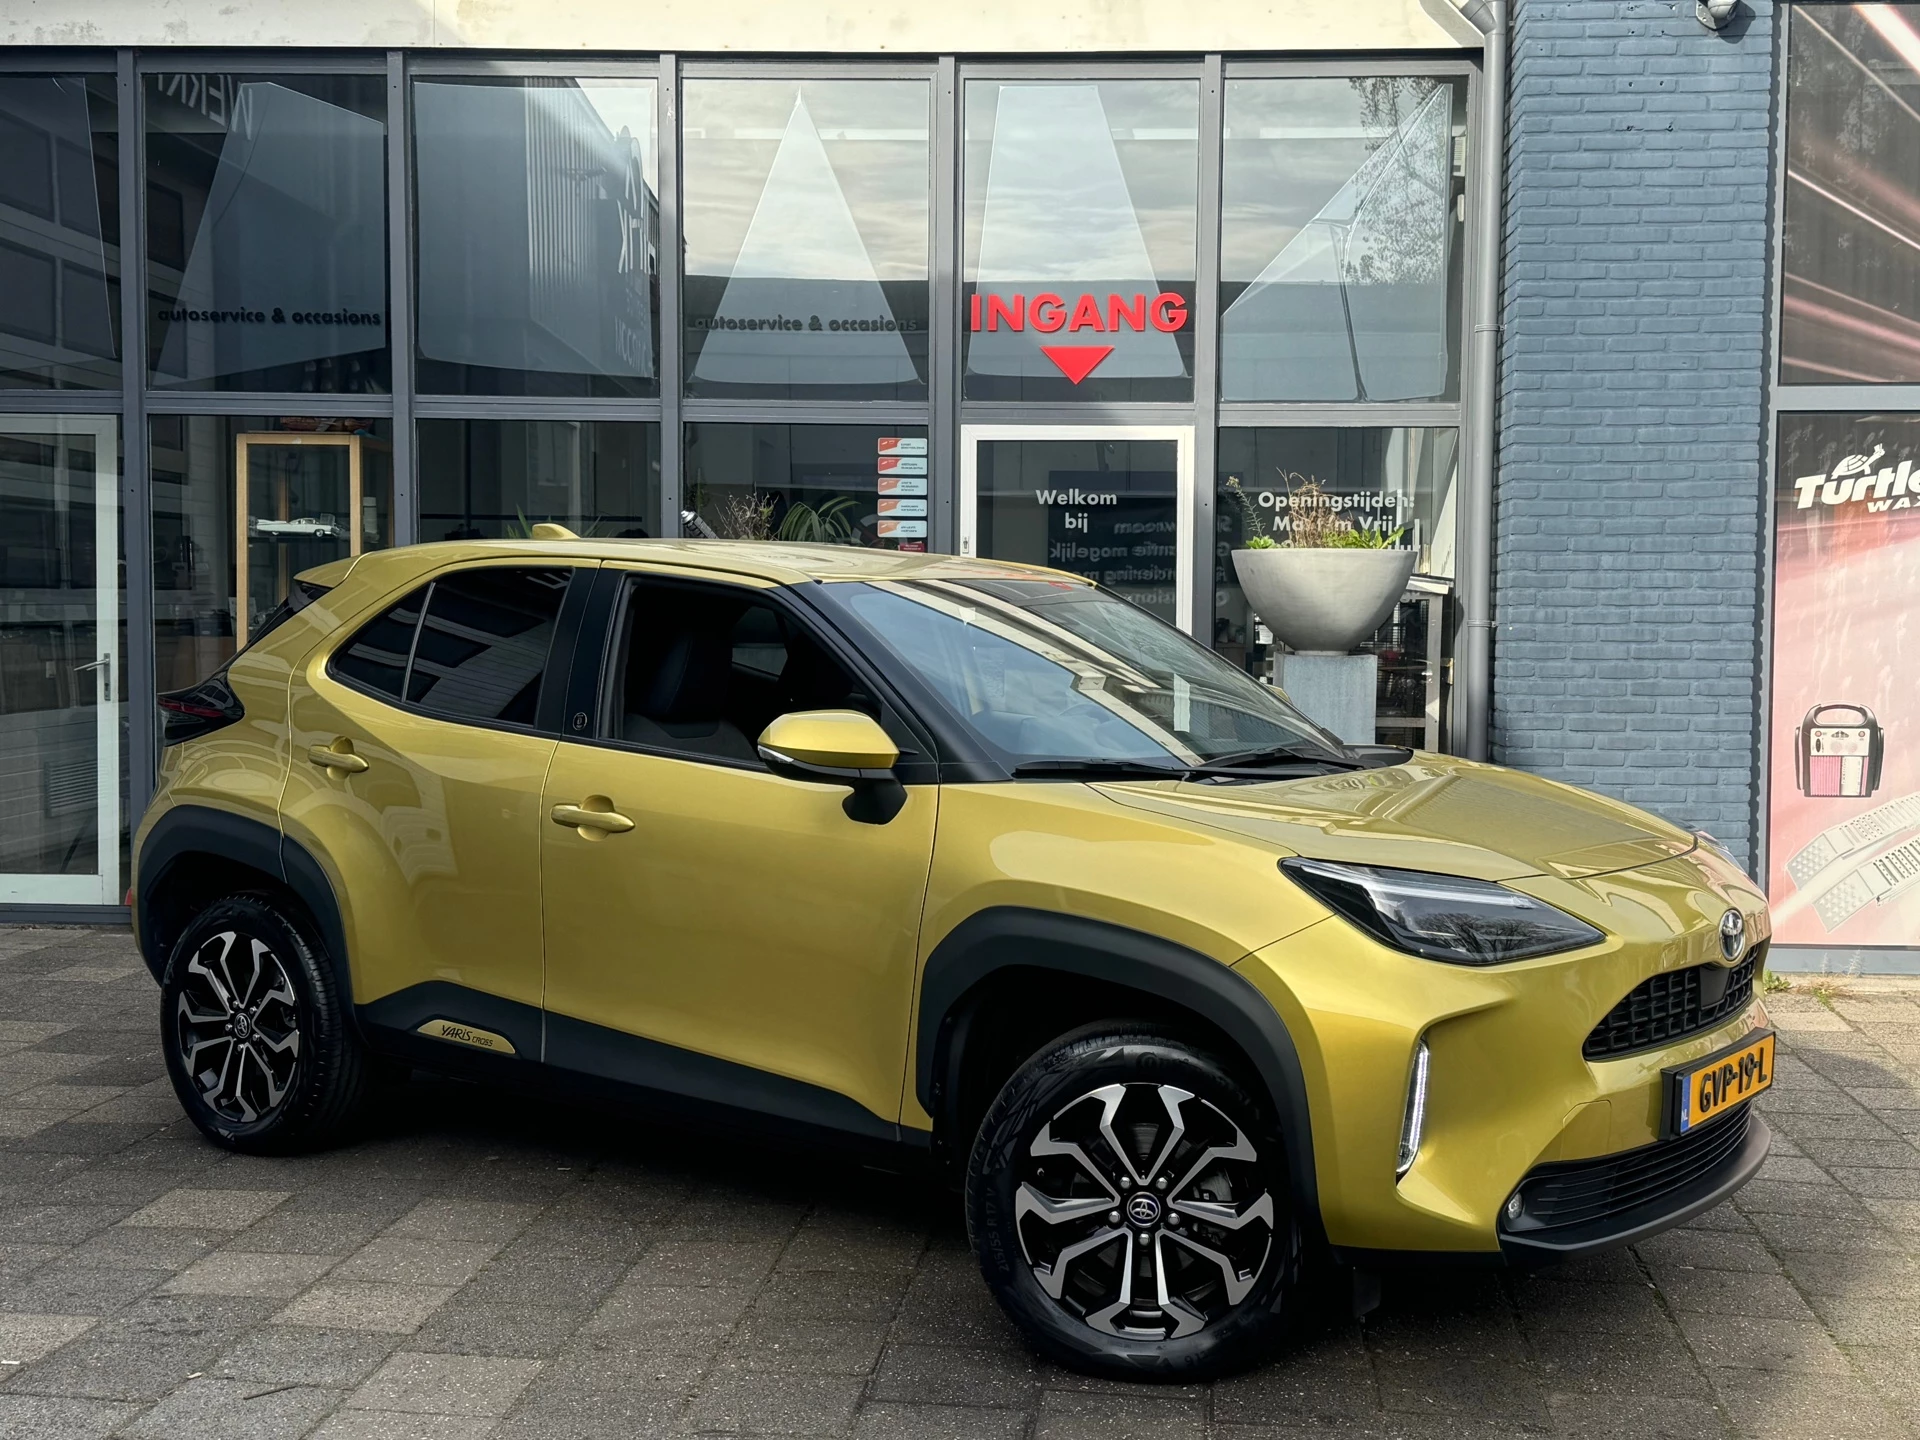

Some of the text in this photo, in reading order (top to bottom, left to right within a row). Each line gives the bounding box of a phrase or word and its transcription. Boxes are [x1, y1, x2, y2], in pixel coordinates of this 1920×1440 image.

[157, 306, 382, 326] autoservice & occasions
[694, 313, 917, 332] autoservice & occasions
[970, 292, 1189, 334] INGANG
[1035, 488, 1118, 506] Welkom
[1064, 512, 1089, 534] bij
[1699, 1046, 1768, 1113] GVP-19-L
[1681, 1108, 1689, 1121] NL
